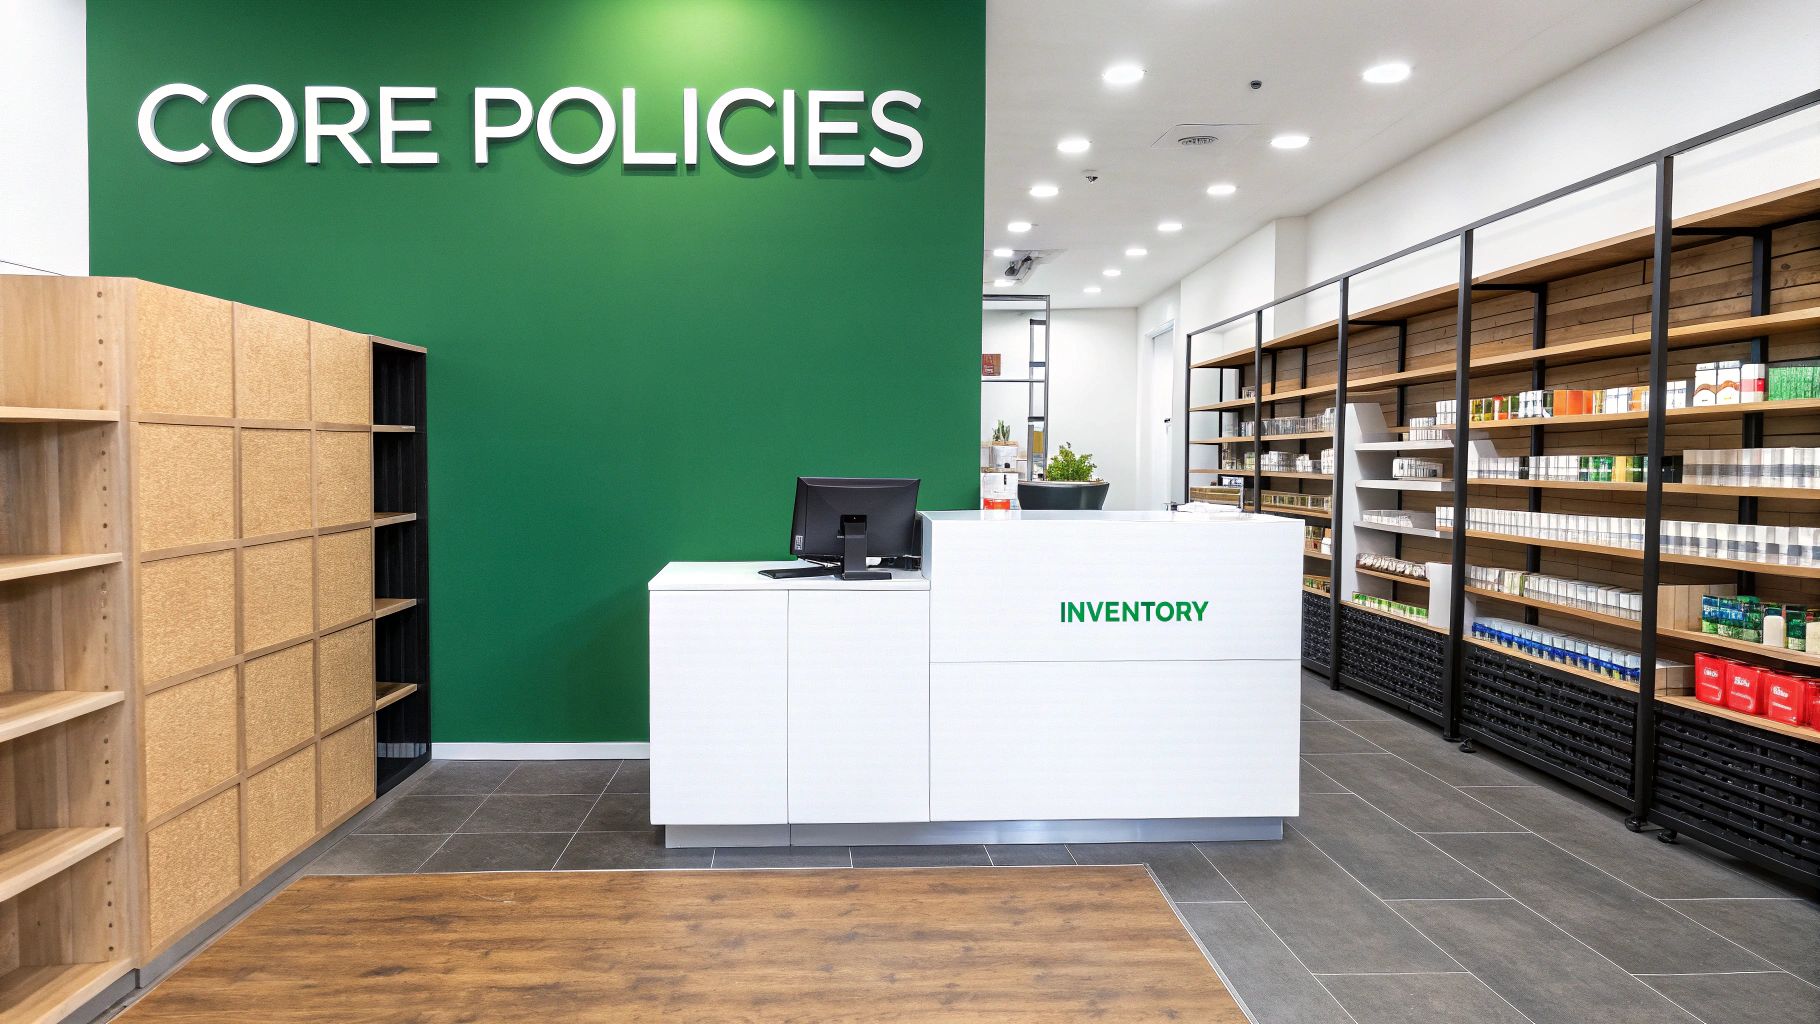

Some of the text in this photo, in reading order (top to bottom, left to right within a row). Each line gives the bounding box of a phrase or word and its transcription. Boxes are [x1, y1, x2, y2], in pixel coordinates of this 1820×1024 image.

[137, 83, 924, 168] CORE POLICIES
[1059, 599, 1208, 623] INVENTORY
